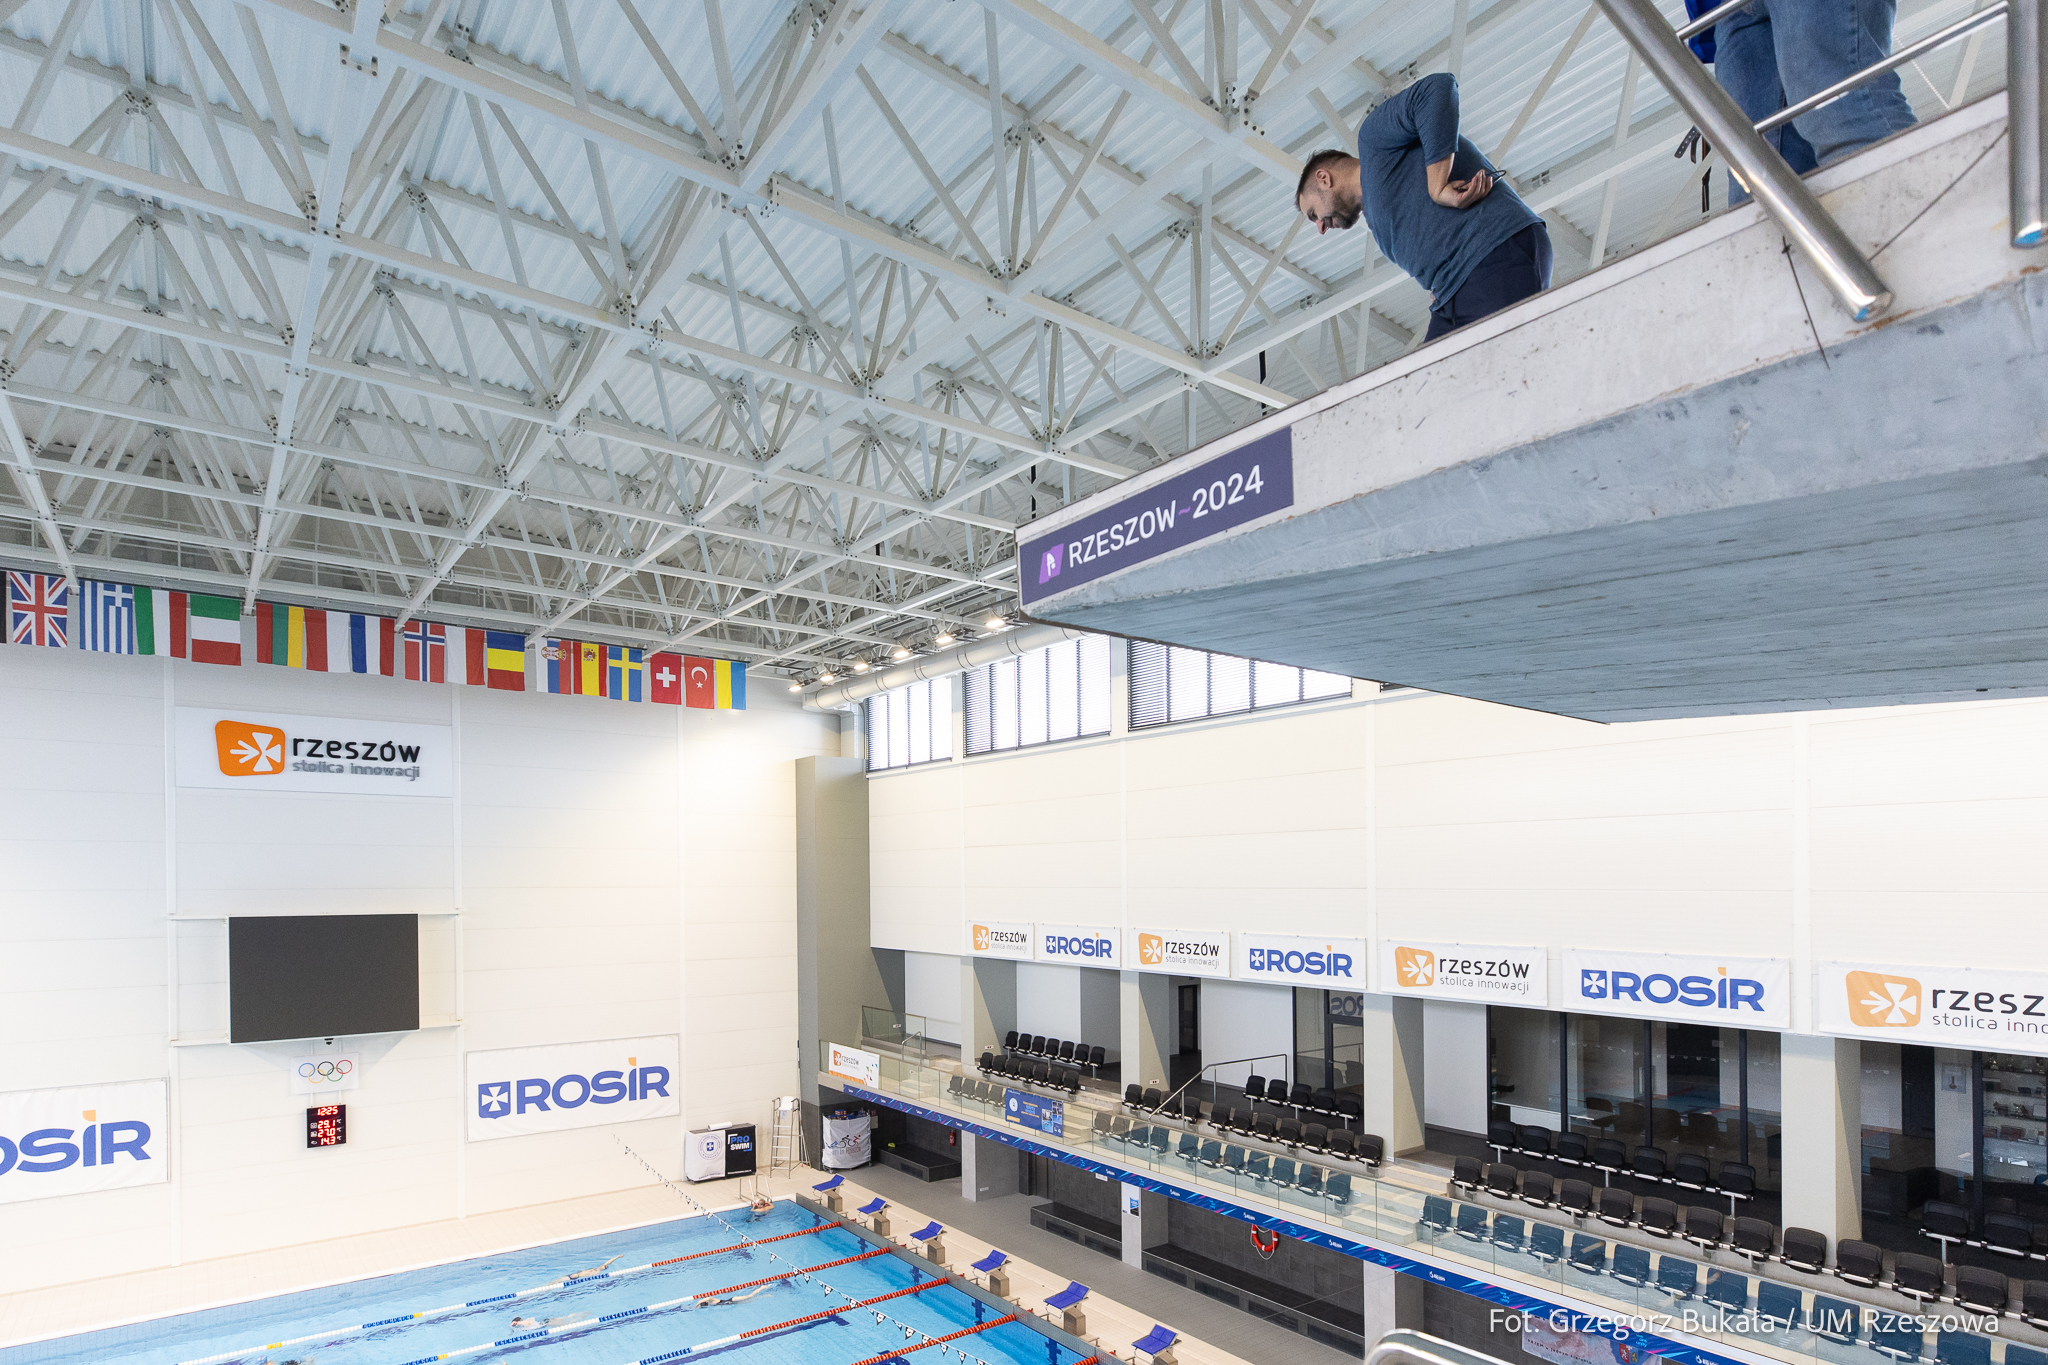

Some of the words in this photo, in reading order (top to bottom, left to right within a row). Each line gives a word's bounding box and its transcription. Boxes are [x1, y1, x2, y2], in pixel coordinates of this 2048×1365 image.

[293, 738, 420, 763] rzeszów
[292, 760, 344, 774] stolica
[350, 763, 420, 781] innowacji
[990, 931, 1027, 943] rzeszów
[1165, 940, 1220, 957] rzeszów
[1165, 954, 1186, 964] stolica
[1188, 957, 1220, 969] innowacji
[1439, 957, 1530, 979] rzeszów
[1440, 976, 1474, 988] stolica
[1478, 978, 1530, 995] innowacji
[1932, 1013, 1998, 1031] stolica
[730, 1142, 750, 1151] SWIM
[731, 1135, 750, 1144] PRO
